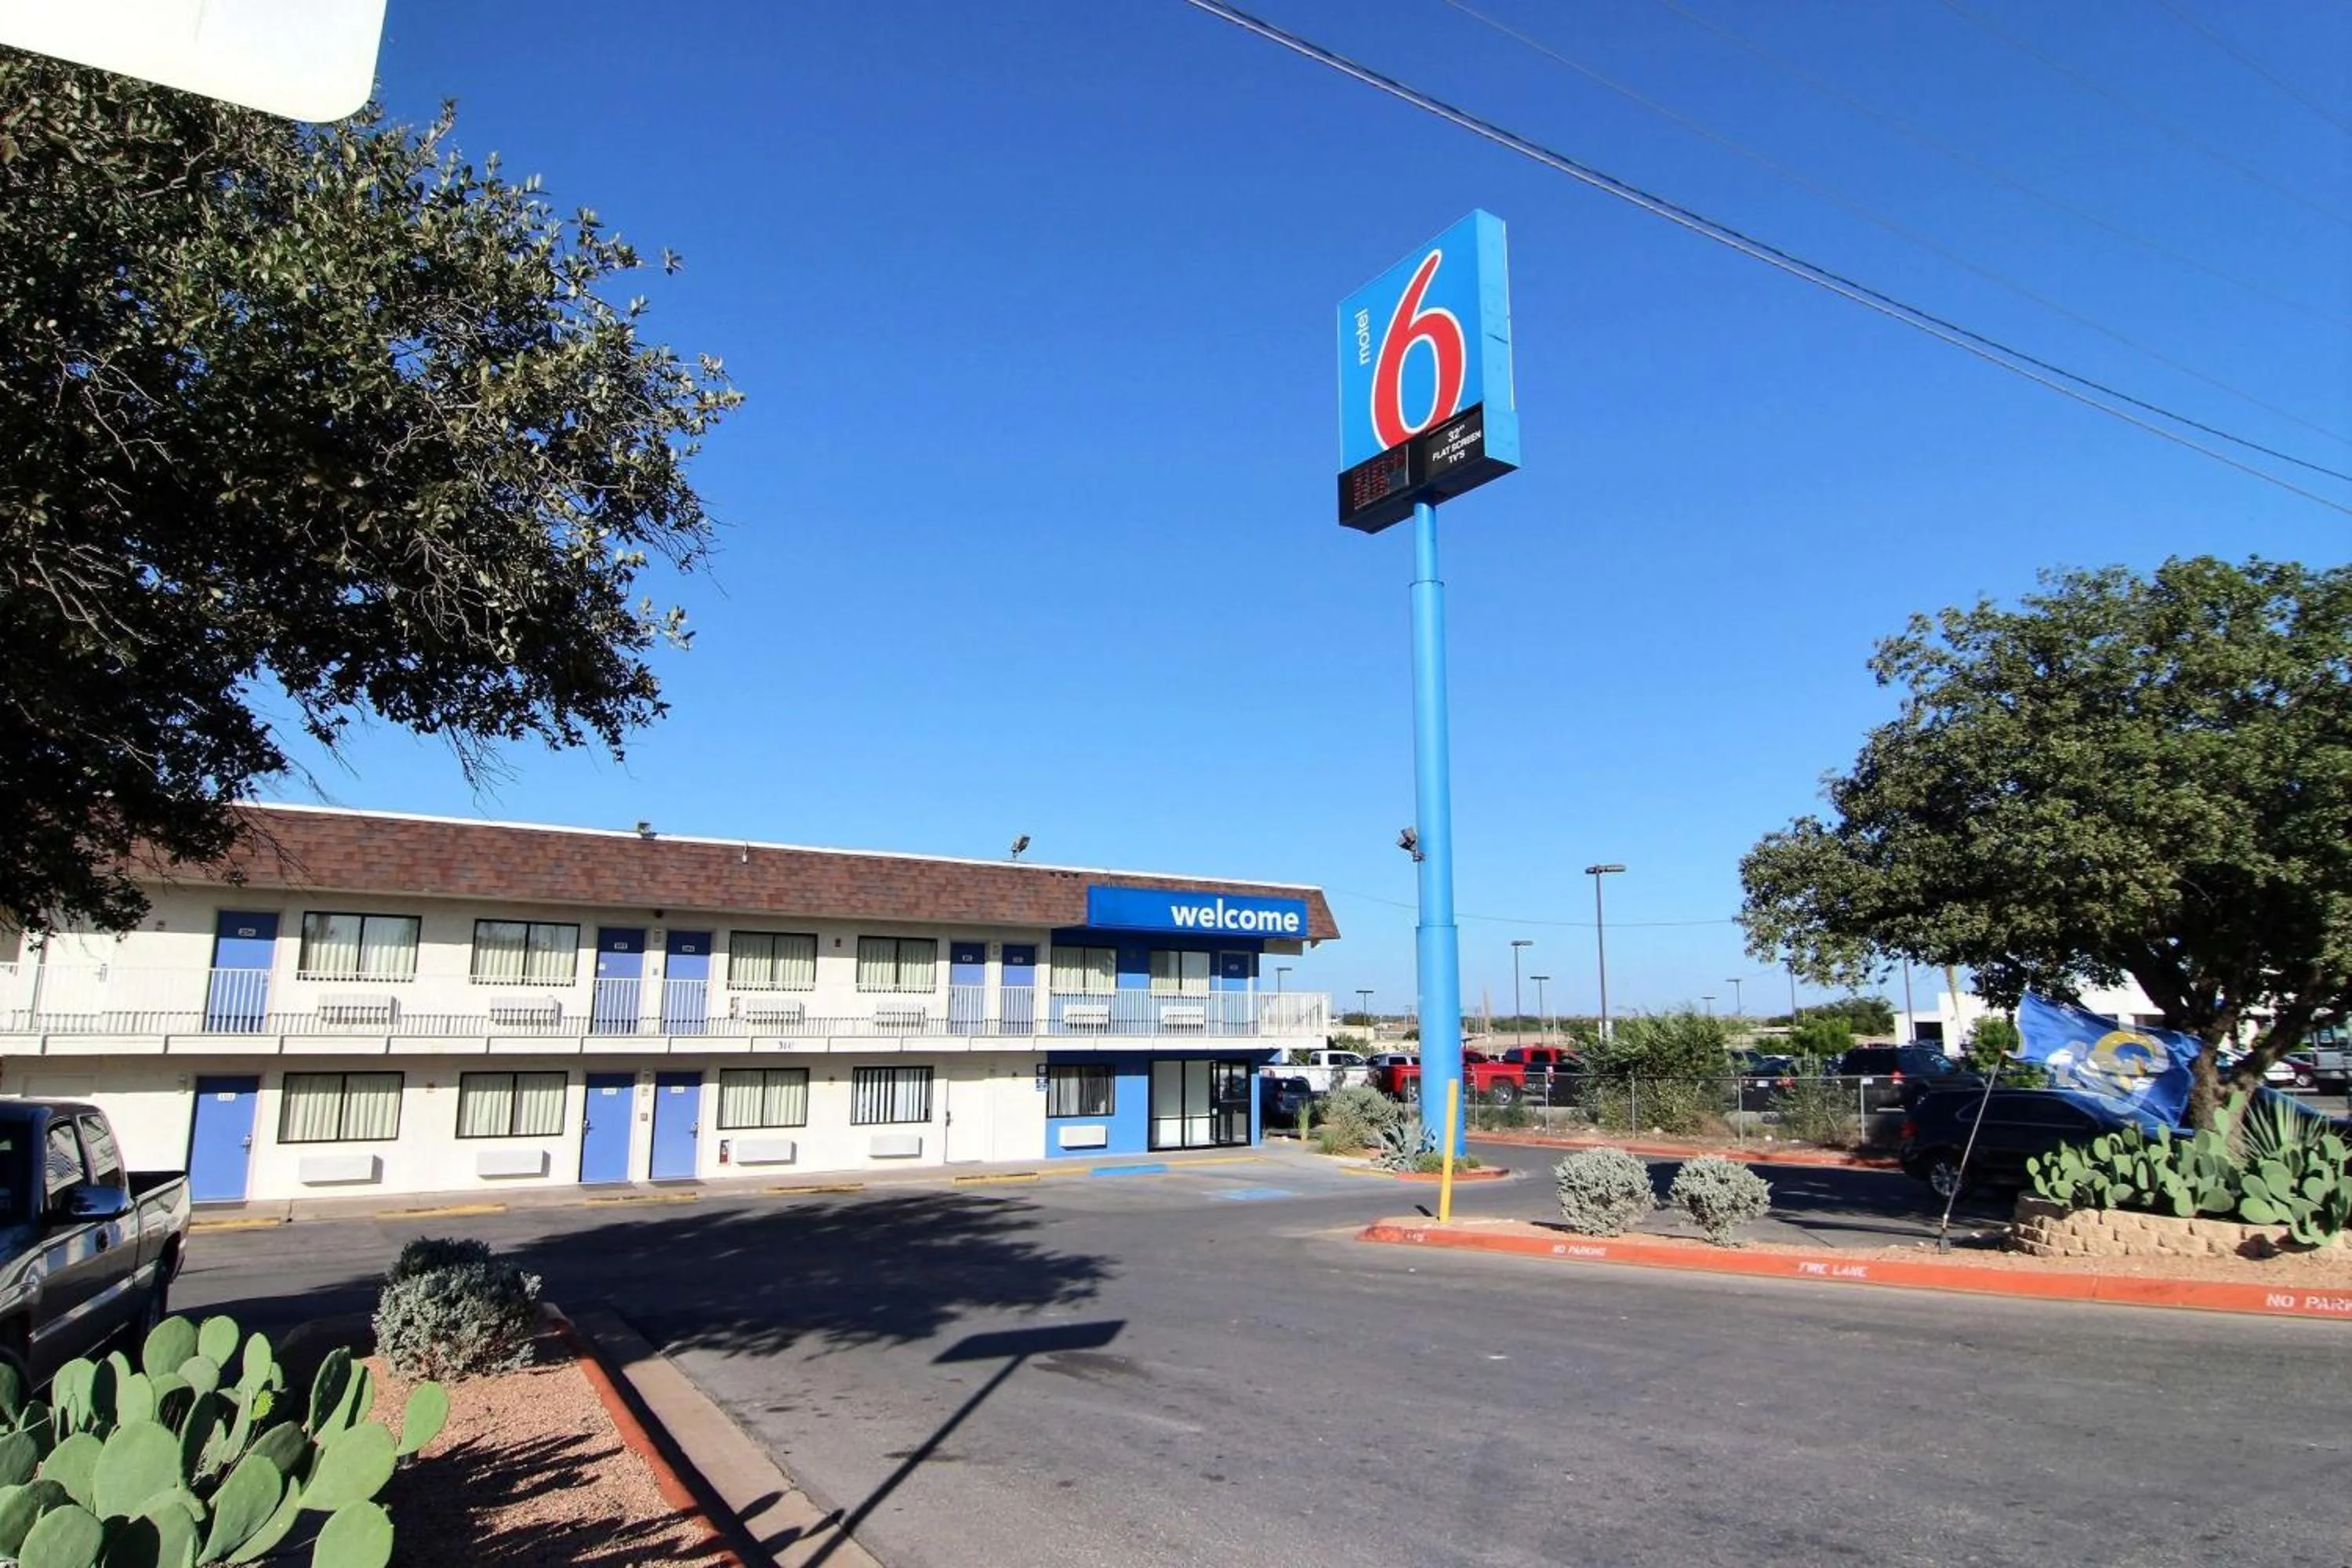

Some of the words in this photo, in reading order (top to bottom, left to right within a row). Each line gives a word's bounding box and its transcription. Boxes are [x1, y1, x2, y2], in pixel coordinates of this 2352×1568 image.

[1354, 307, 1371, 366] motel
[1432, 445, 1450, 462] FLAT
[1451, 430, 1481, 452] SCREEN
[1171, 898, 1299, 932] welcome
[1553, 1243, 1566, 1254] NO
[1798, 1261, 1829, 1275] FIRE
[1832, 1264, 1869, 1278] LANE
[2265, 1293, 2295, 1308] NO
